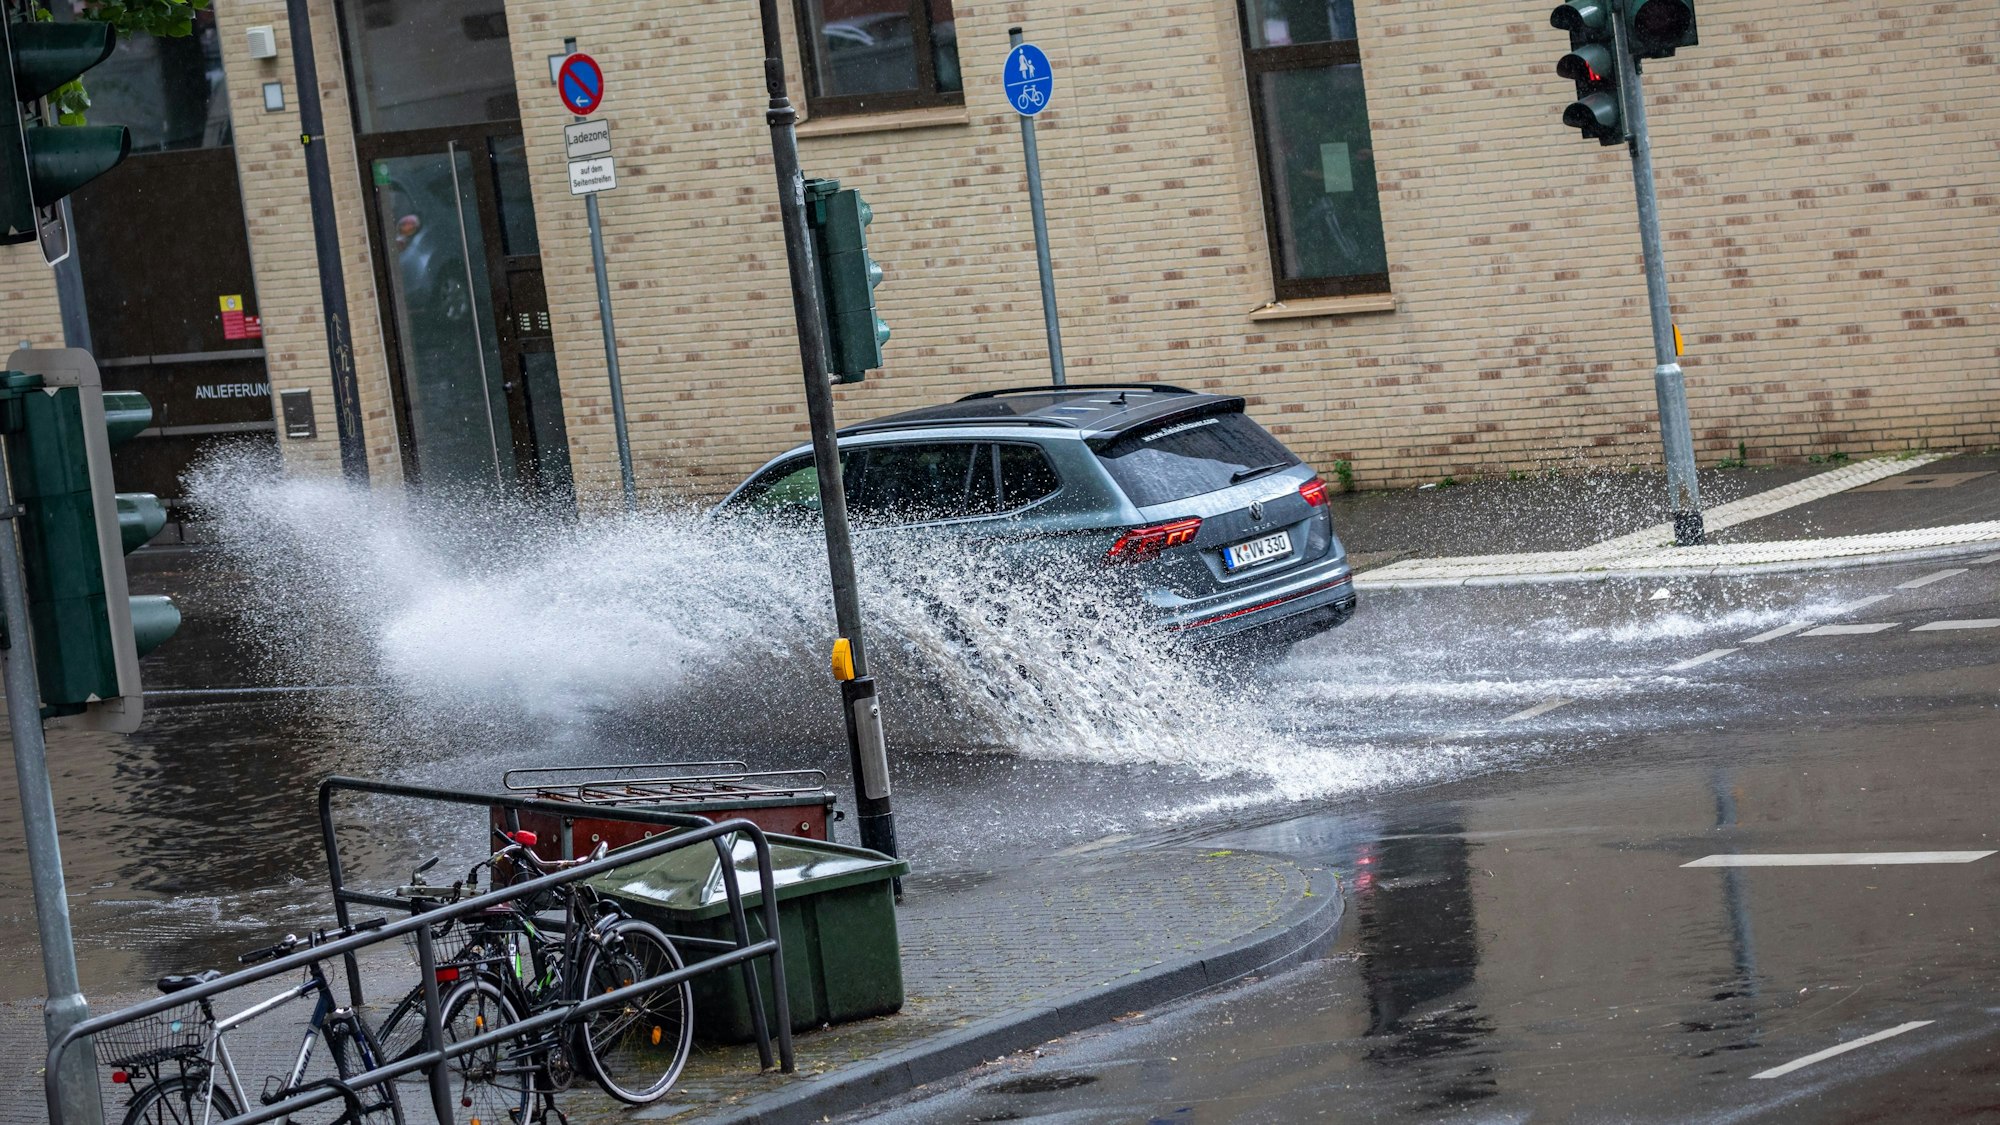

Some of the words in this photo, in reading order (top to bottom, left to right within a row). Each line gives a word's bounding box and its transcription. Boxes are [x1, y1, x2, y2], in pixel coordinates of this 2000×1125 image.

[567, 130, 607, 145] Ladezone
[580, 165, 590, 175] auf
[591, 165, 602, 173] dem
[573, 175, 611, 187] Seitenstreifen
[1264, 535, 1287, 554] 330
